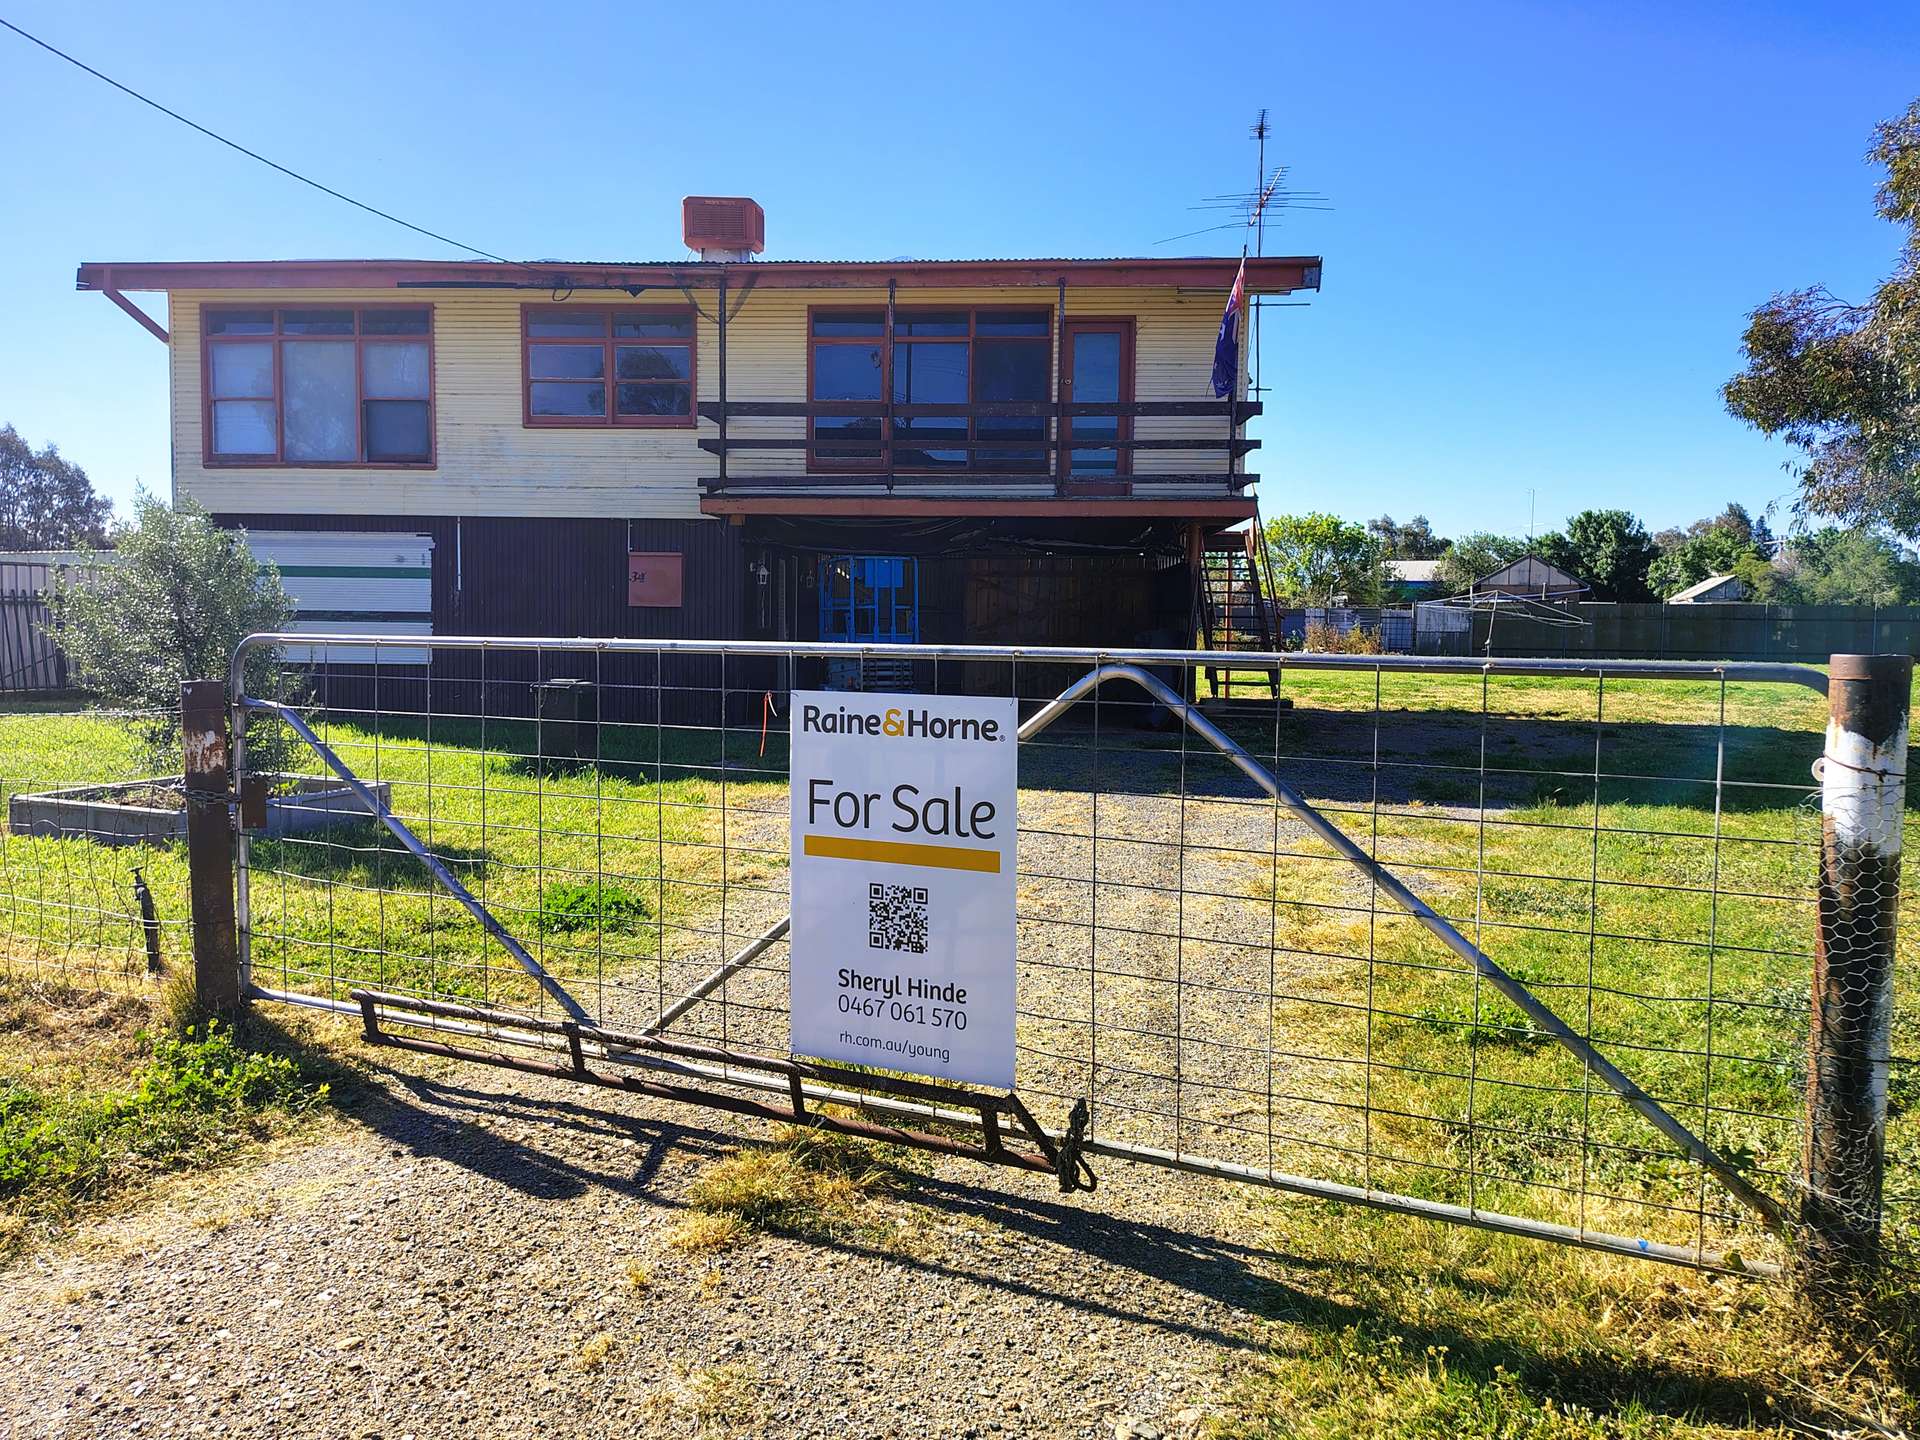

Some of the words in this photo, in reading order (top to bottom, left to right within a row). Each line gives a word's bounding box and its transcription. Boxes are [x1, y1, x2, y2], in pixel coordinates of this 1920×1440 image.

[809, 778, 881, 829] For
[891, 784, 996, 840] Sale
[838, 968, 902, 999] Sheryl
[907, 977, 967, 1004] Hinde
[838, 994, 886, 1018] 0467
[890, 1001, 926, 1025] 061
[931, 1008, 967, 1030] 570
[839, 1030, 950, 1063] rh.com.au/young
